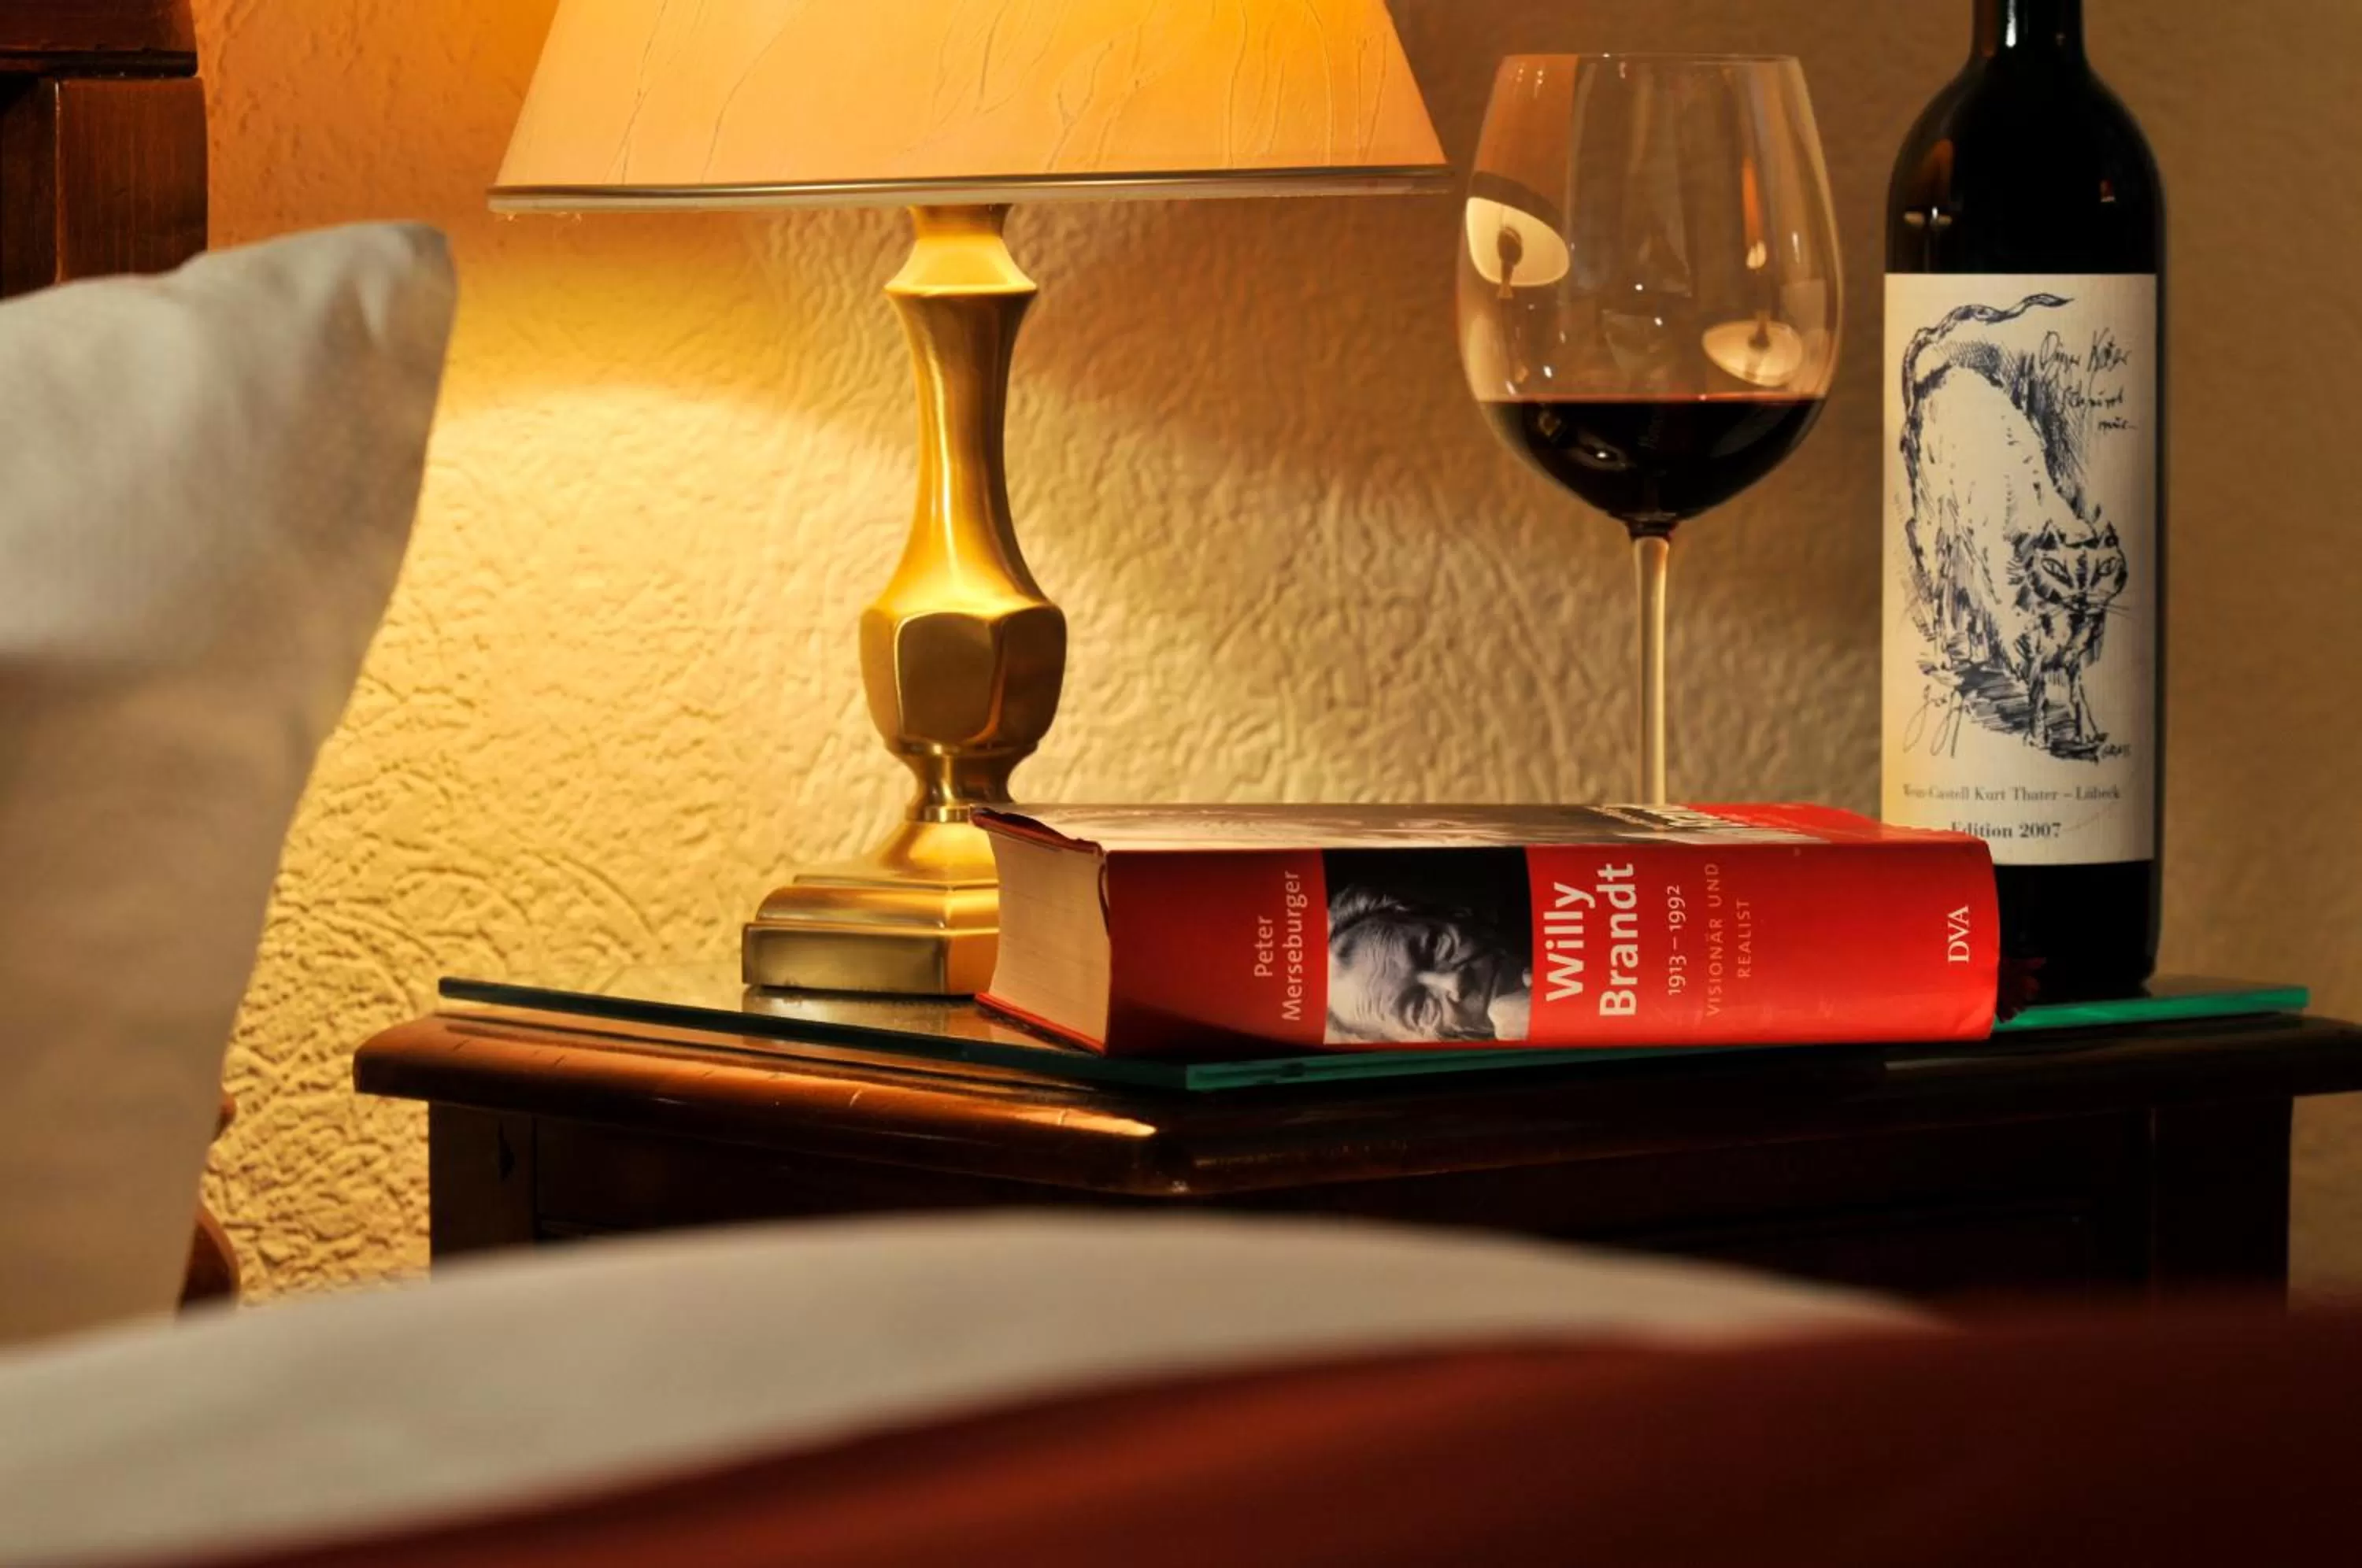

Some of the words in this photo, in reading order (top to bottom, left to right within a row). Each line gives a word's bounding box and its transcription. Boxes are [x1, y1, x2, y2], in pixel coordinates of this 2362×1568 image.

[1974, 786, 2006, 801] Kurt
[2019, 822, 2062, 838] 2007
[1704, 863, 1723, 908] UND
[1253, 915, 1274, 977] Peter
[1282, 870, 1308, 1021] Merseburger
[1543, 881, 1596, 1002] Willy
[1596, 863, 1638, 1016] Brandt
[1704, 918, 1724, 1017] VISIONÄR
[1736, 897, 1752, 979] REALIST
[1947, 904, 1971, 964] DVA
